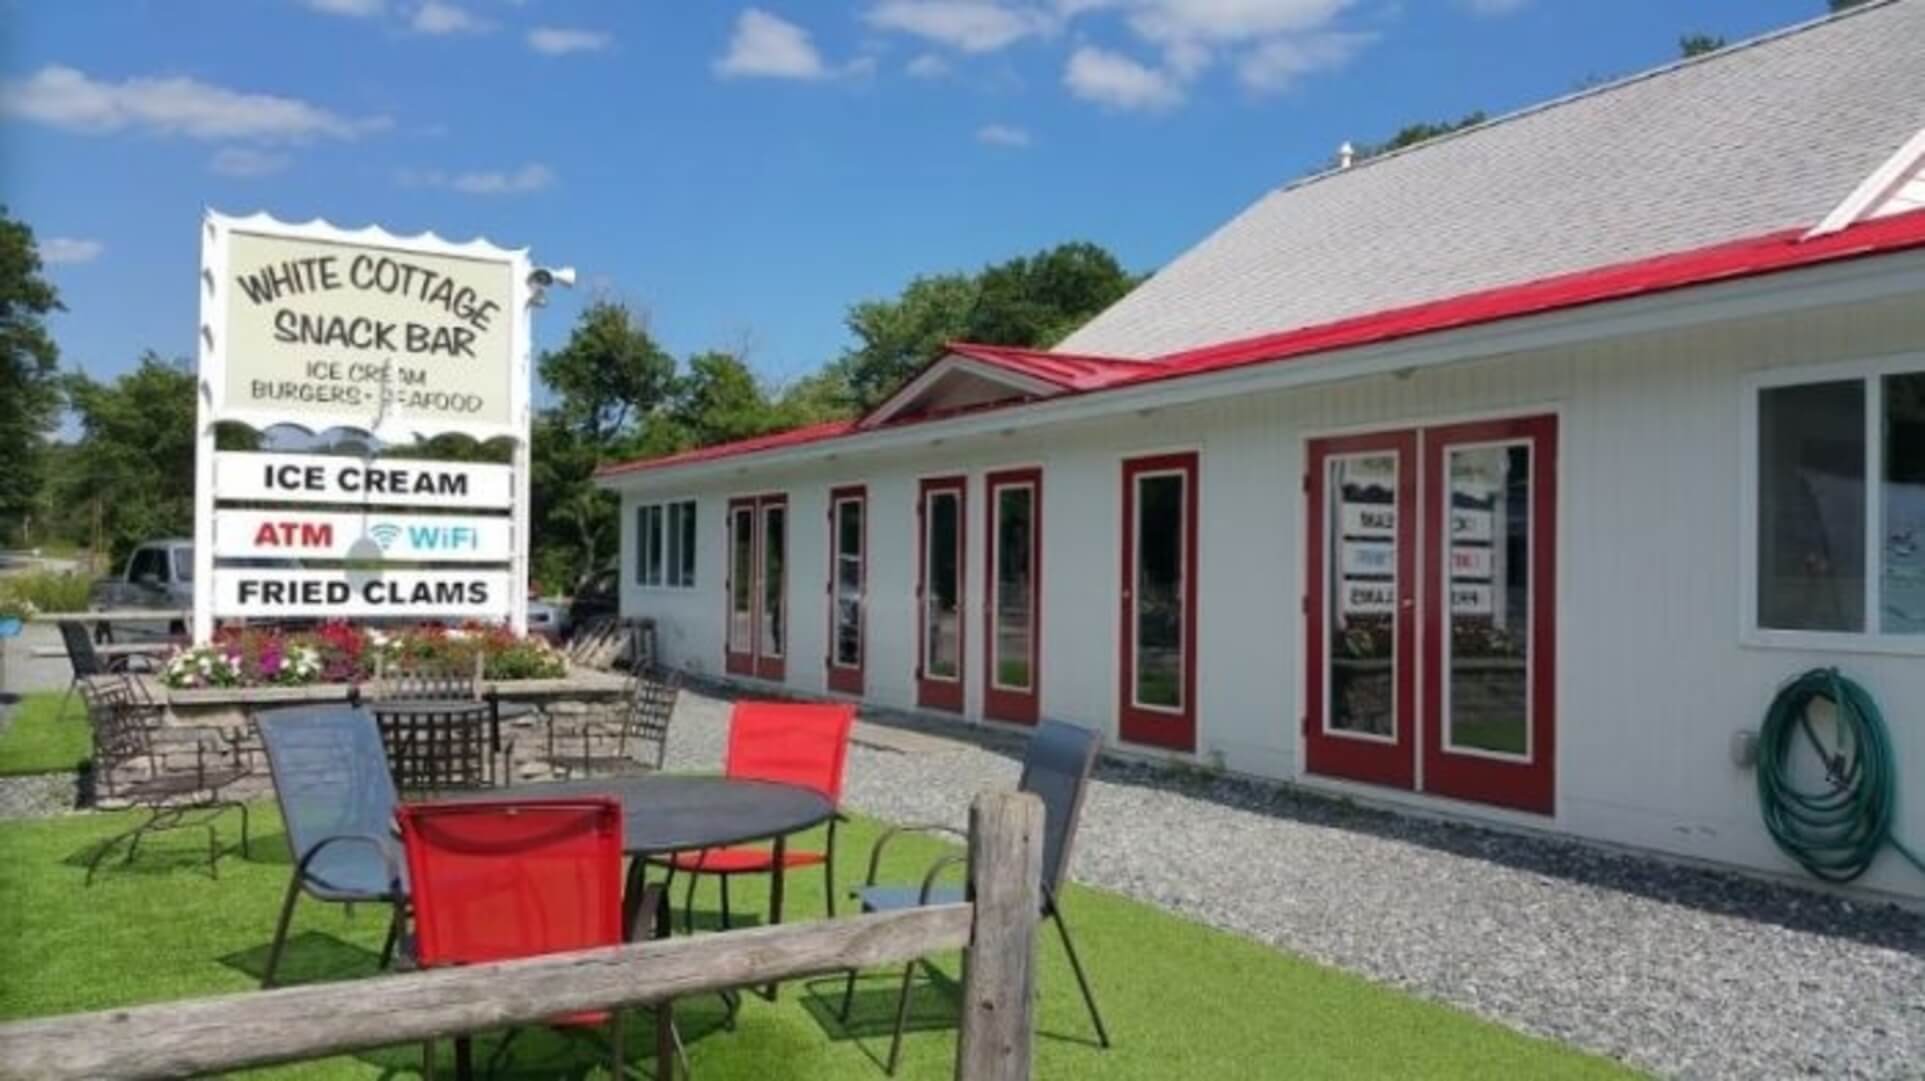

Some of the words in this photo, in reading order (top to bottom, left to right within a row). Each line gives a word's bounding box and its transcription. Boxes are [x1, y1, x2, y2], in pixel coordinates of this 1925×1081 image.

[237, 255, 342, 305] WHITE
[350, 254, 501, 332] COTTAGE
[274, 309, 397, 352] SNACK
[405, 323, 478, 359] BAR
[306, 360, 342, 380] ICE
[252, 379, 361, 405] BURGERS
[264, 464, 326, 491] ICE
[337, 466, 469, 496] CREAM
[254, 522, 334, 548] ATM
[408, 525, 479, 551] WiFi
[237, 580, 351, 605] FRIED
[362, 579, 489, 606] CLAMS
